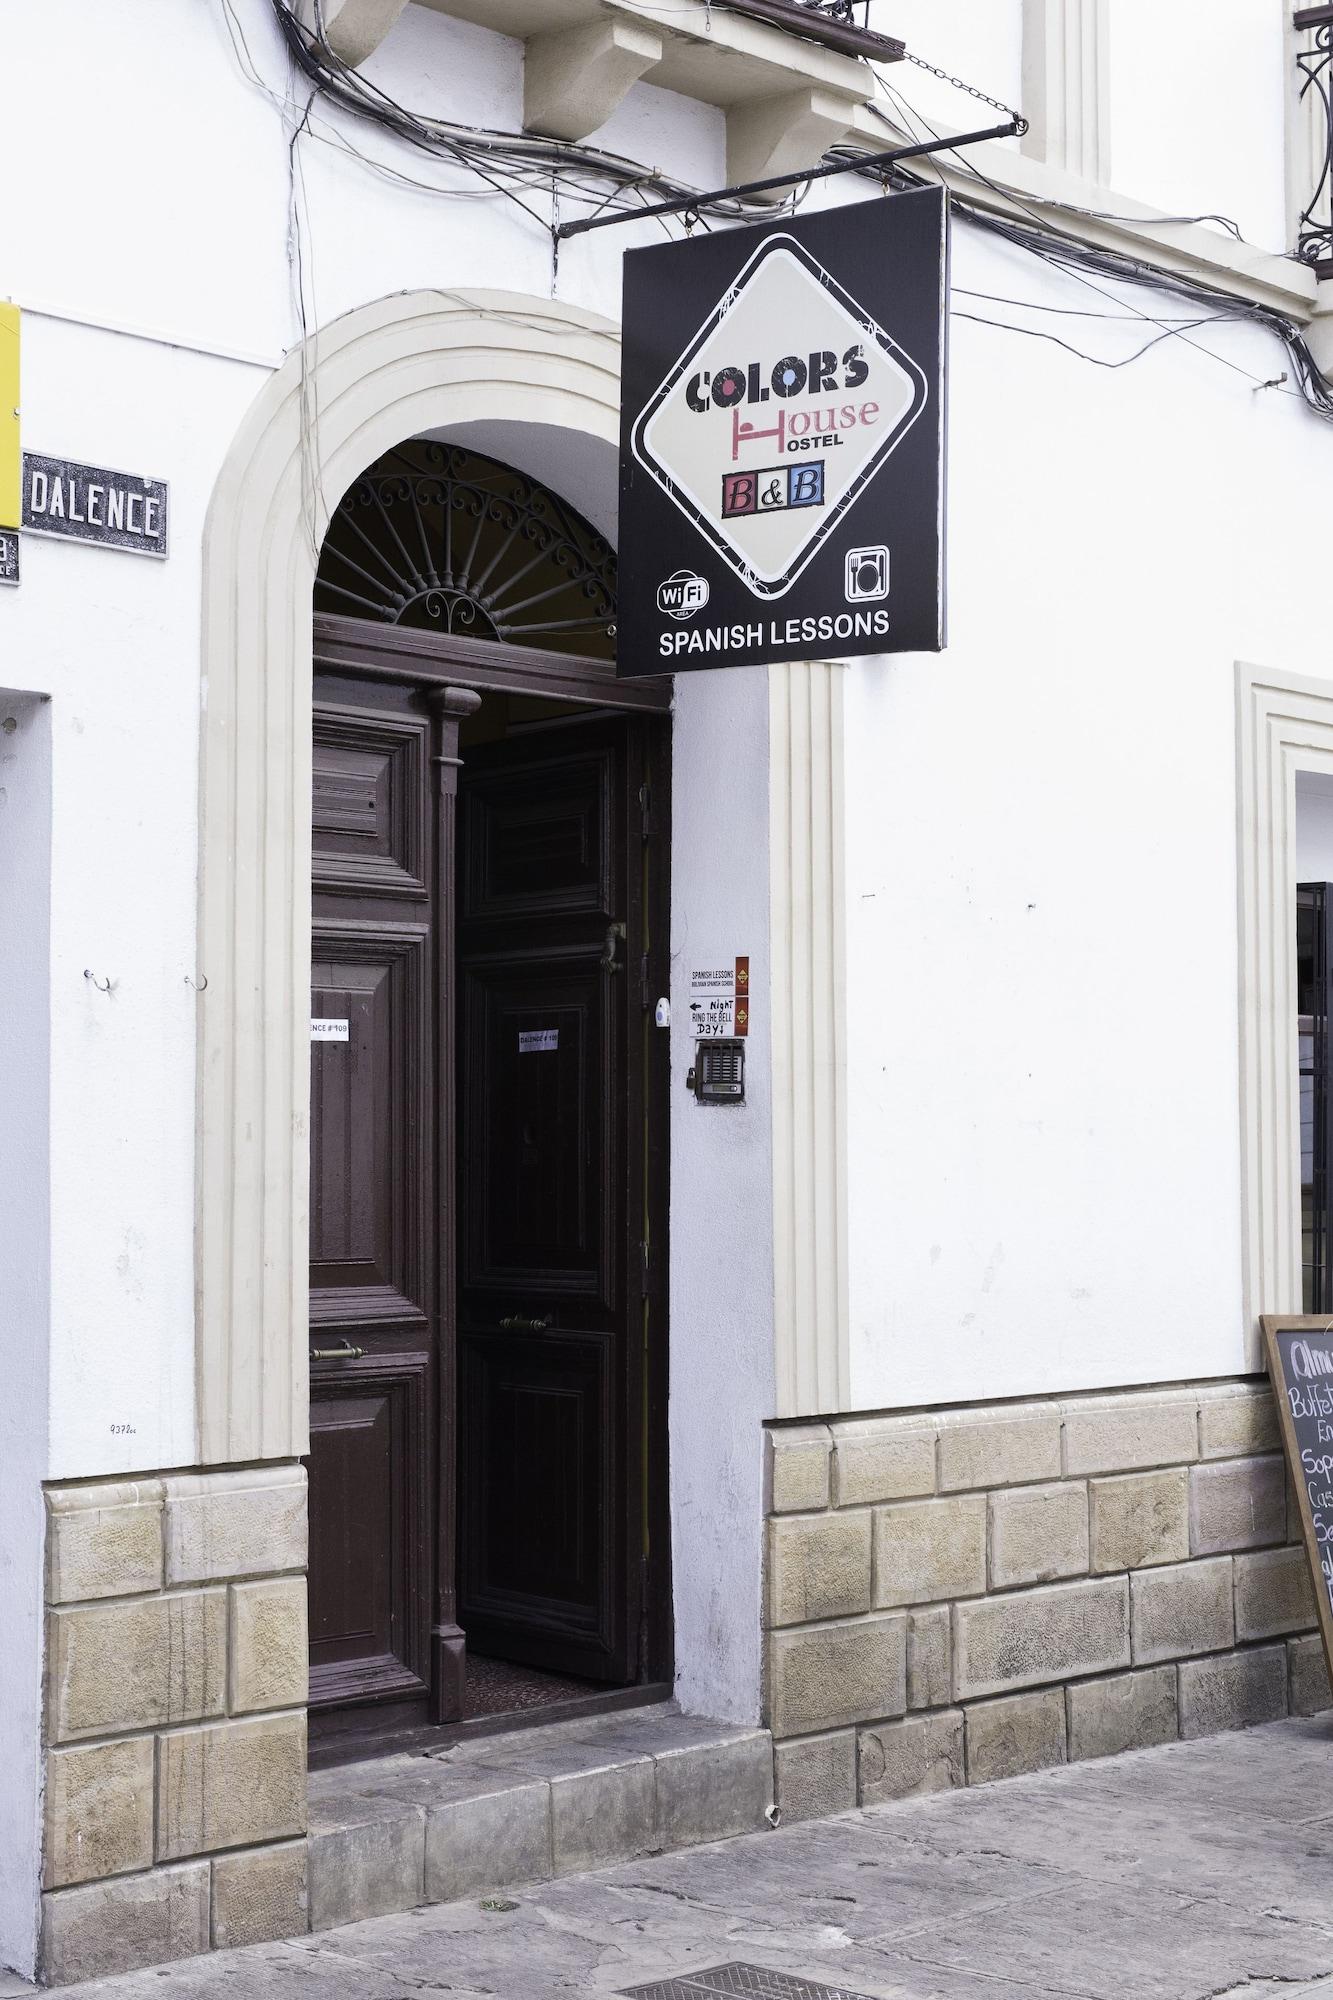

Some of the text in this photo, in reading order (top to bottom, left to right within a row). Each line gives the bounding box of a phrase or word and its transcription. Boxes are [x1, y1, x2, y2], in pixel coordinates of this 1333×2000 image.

[686, 344, 870, 413] COLORS
[30, 471, 160, 538] DALENCE
[659, 610, 890, 657] SPANISH LESSONS
[692, 971, 712, 980] SPANISH
[712, 970, 734, 979] LESSONS
[334, 1024, 348, 1032] 109
[692, 1012, 706, 1022] RING
[706, 1012, 718, 1022] THE
[718, 1012, 732, 1022] BELL
